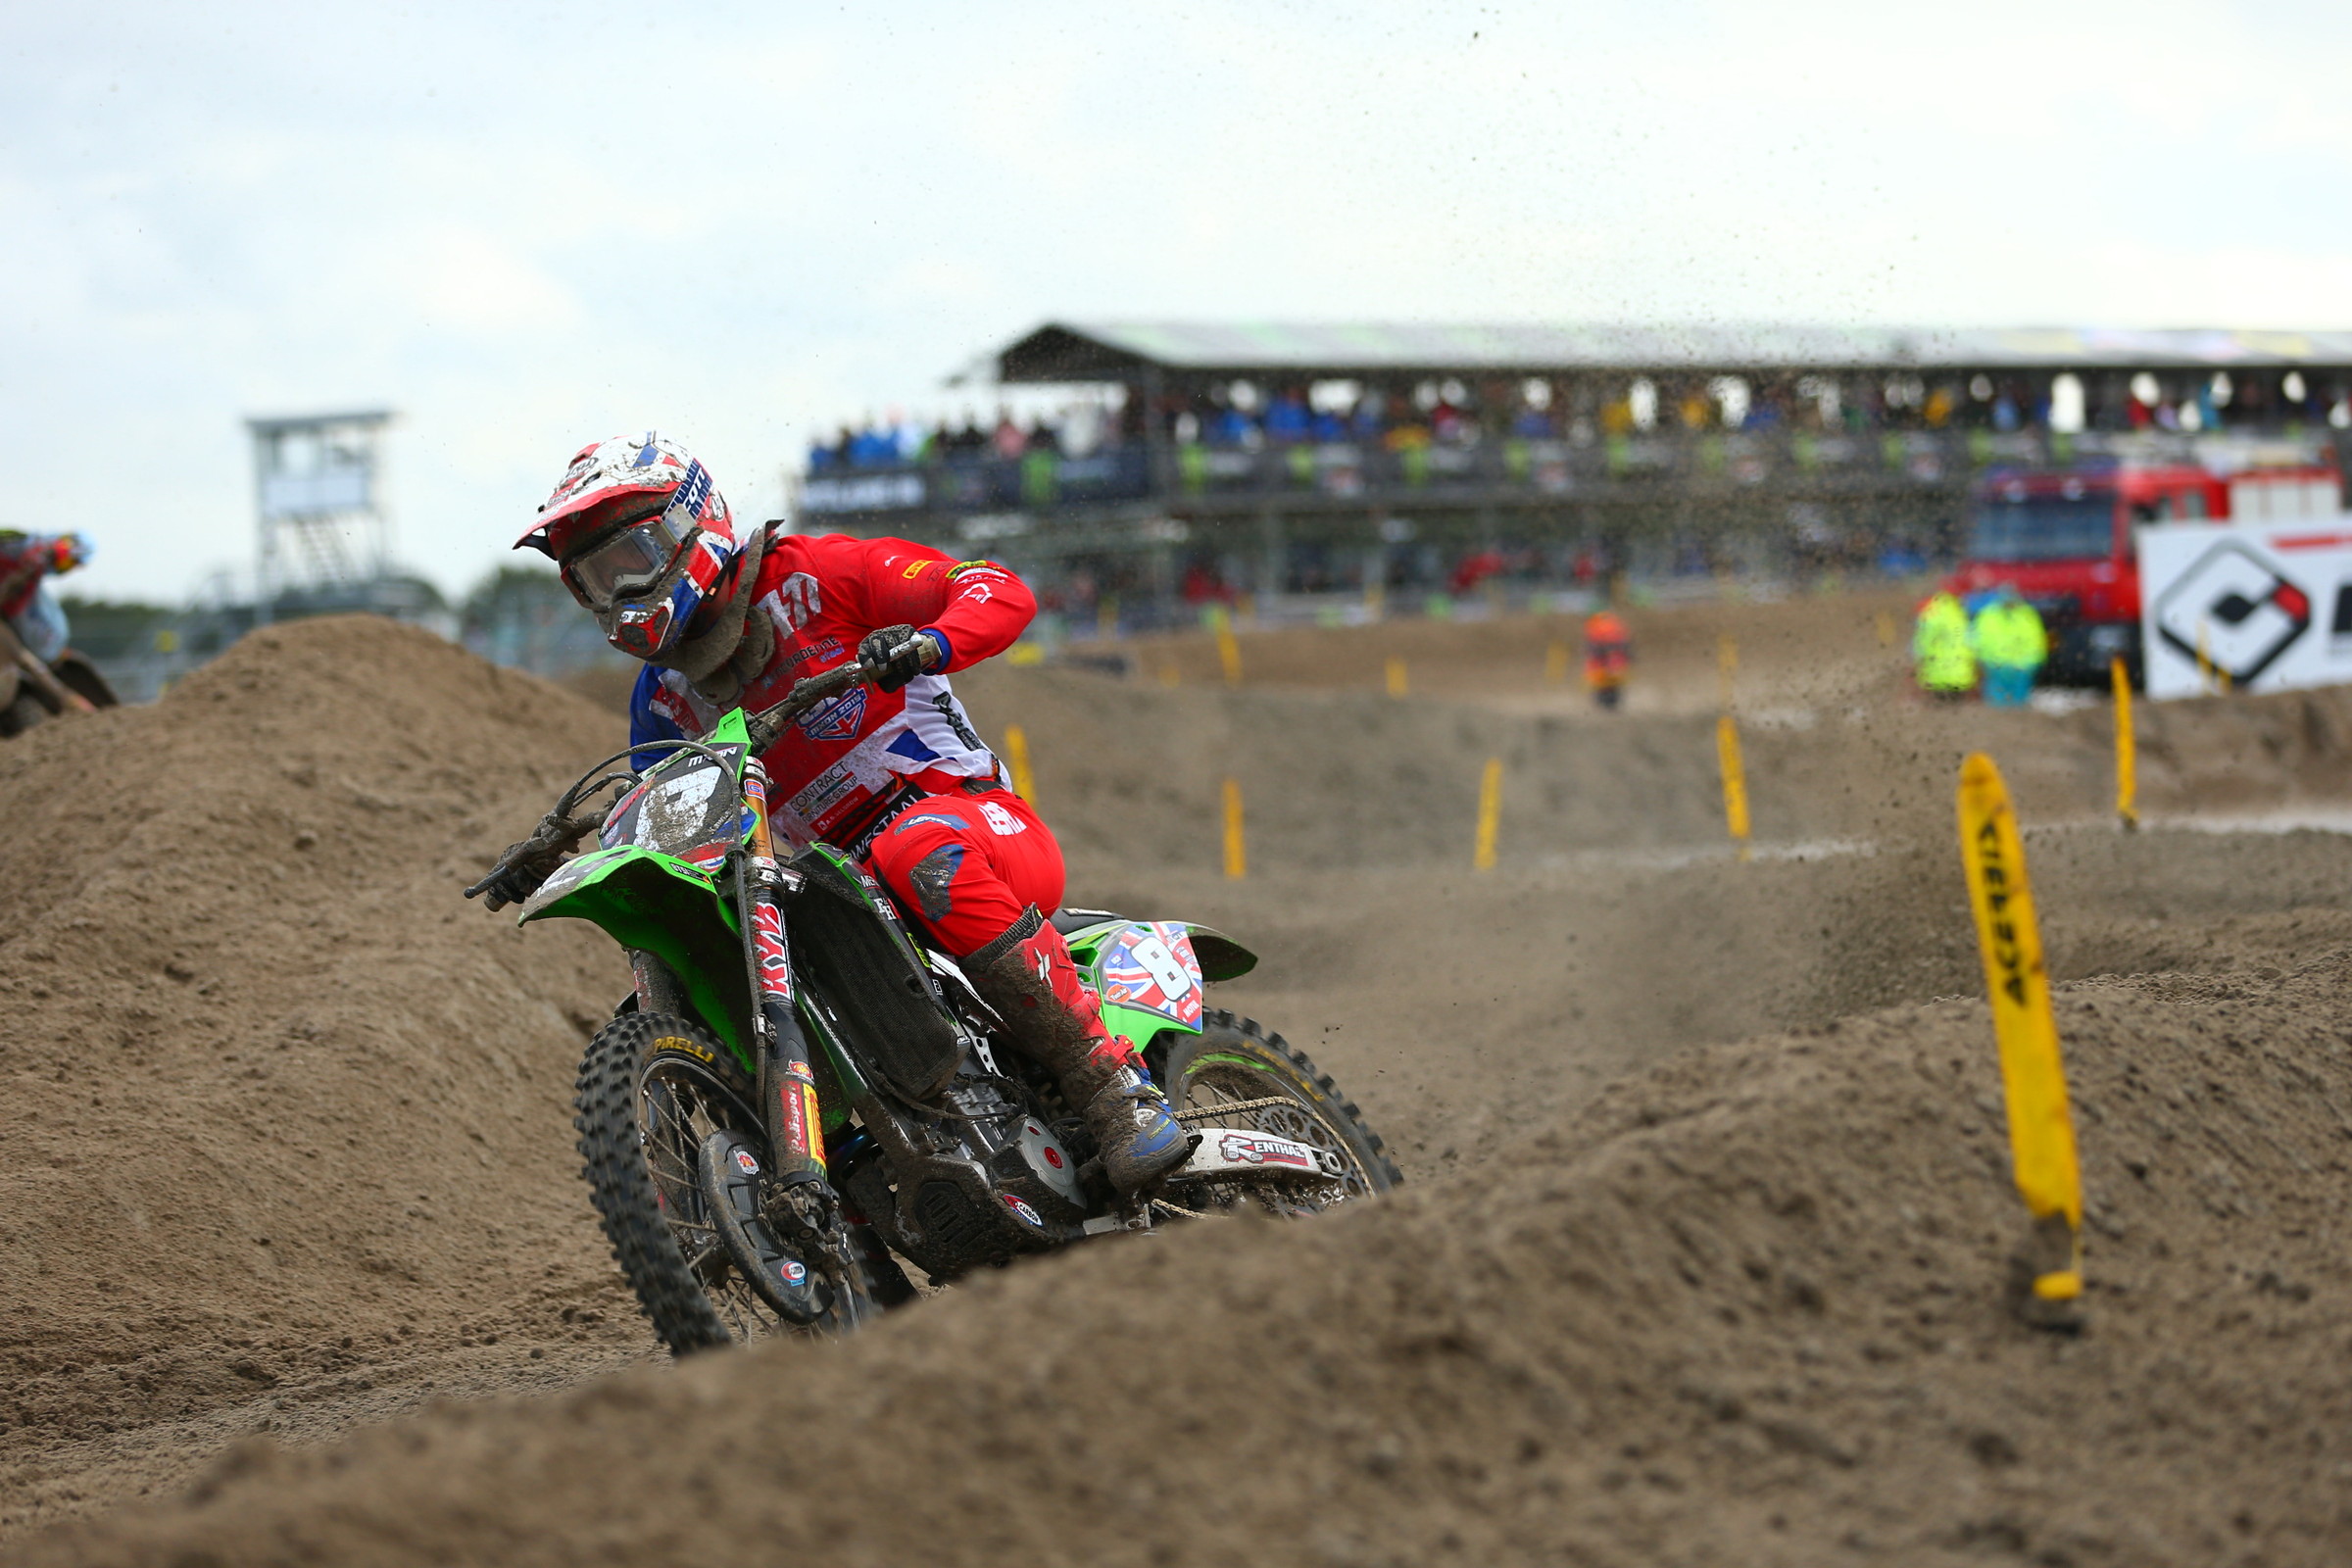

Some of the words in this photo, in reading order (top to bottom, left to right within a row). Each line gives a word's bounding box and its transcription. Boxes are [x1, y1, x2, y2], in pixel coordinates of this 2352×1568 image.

[683, 466, 706, 511] COTT
[837, 693, 862, 714] 2019
[790, 760, 849, 811] CONTRACT
[802, 795, 835, 823] FURNITURE
[832, 775, 858, 801] GROUP
[751, 902, 792, 1001] KYB
[1132, 937, 1191, 1001] 8
[1221, 1137, 1305, 1161] RENTHAL
